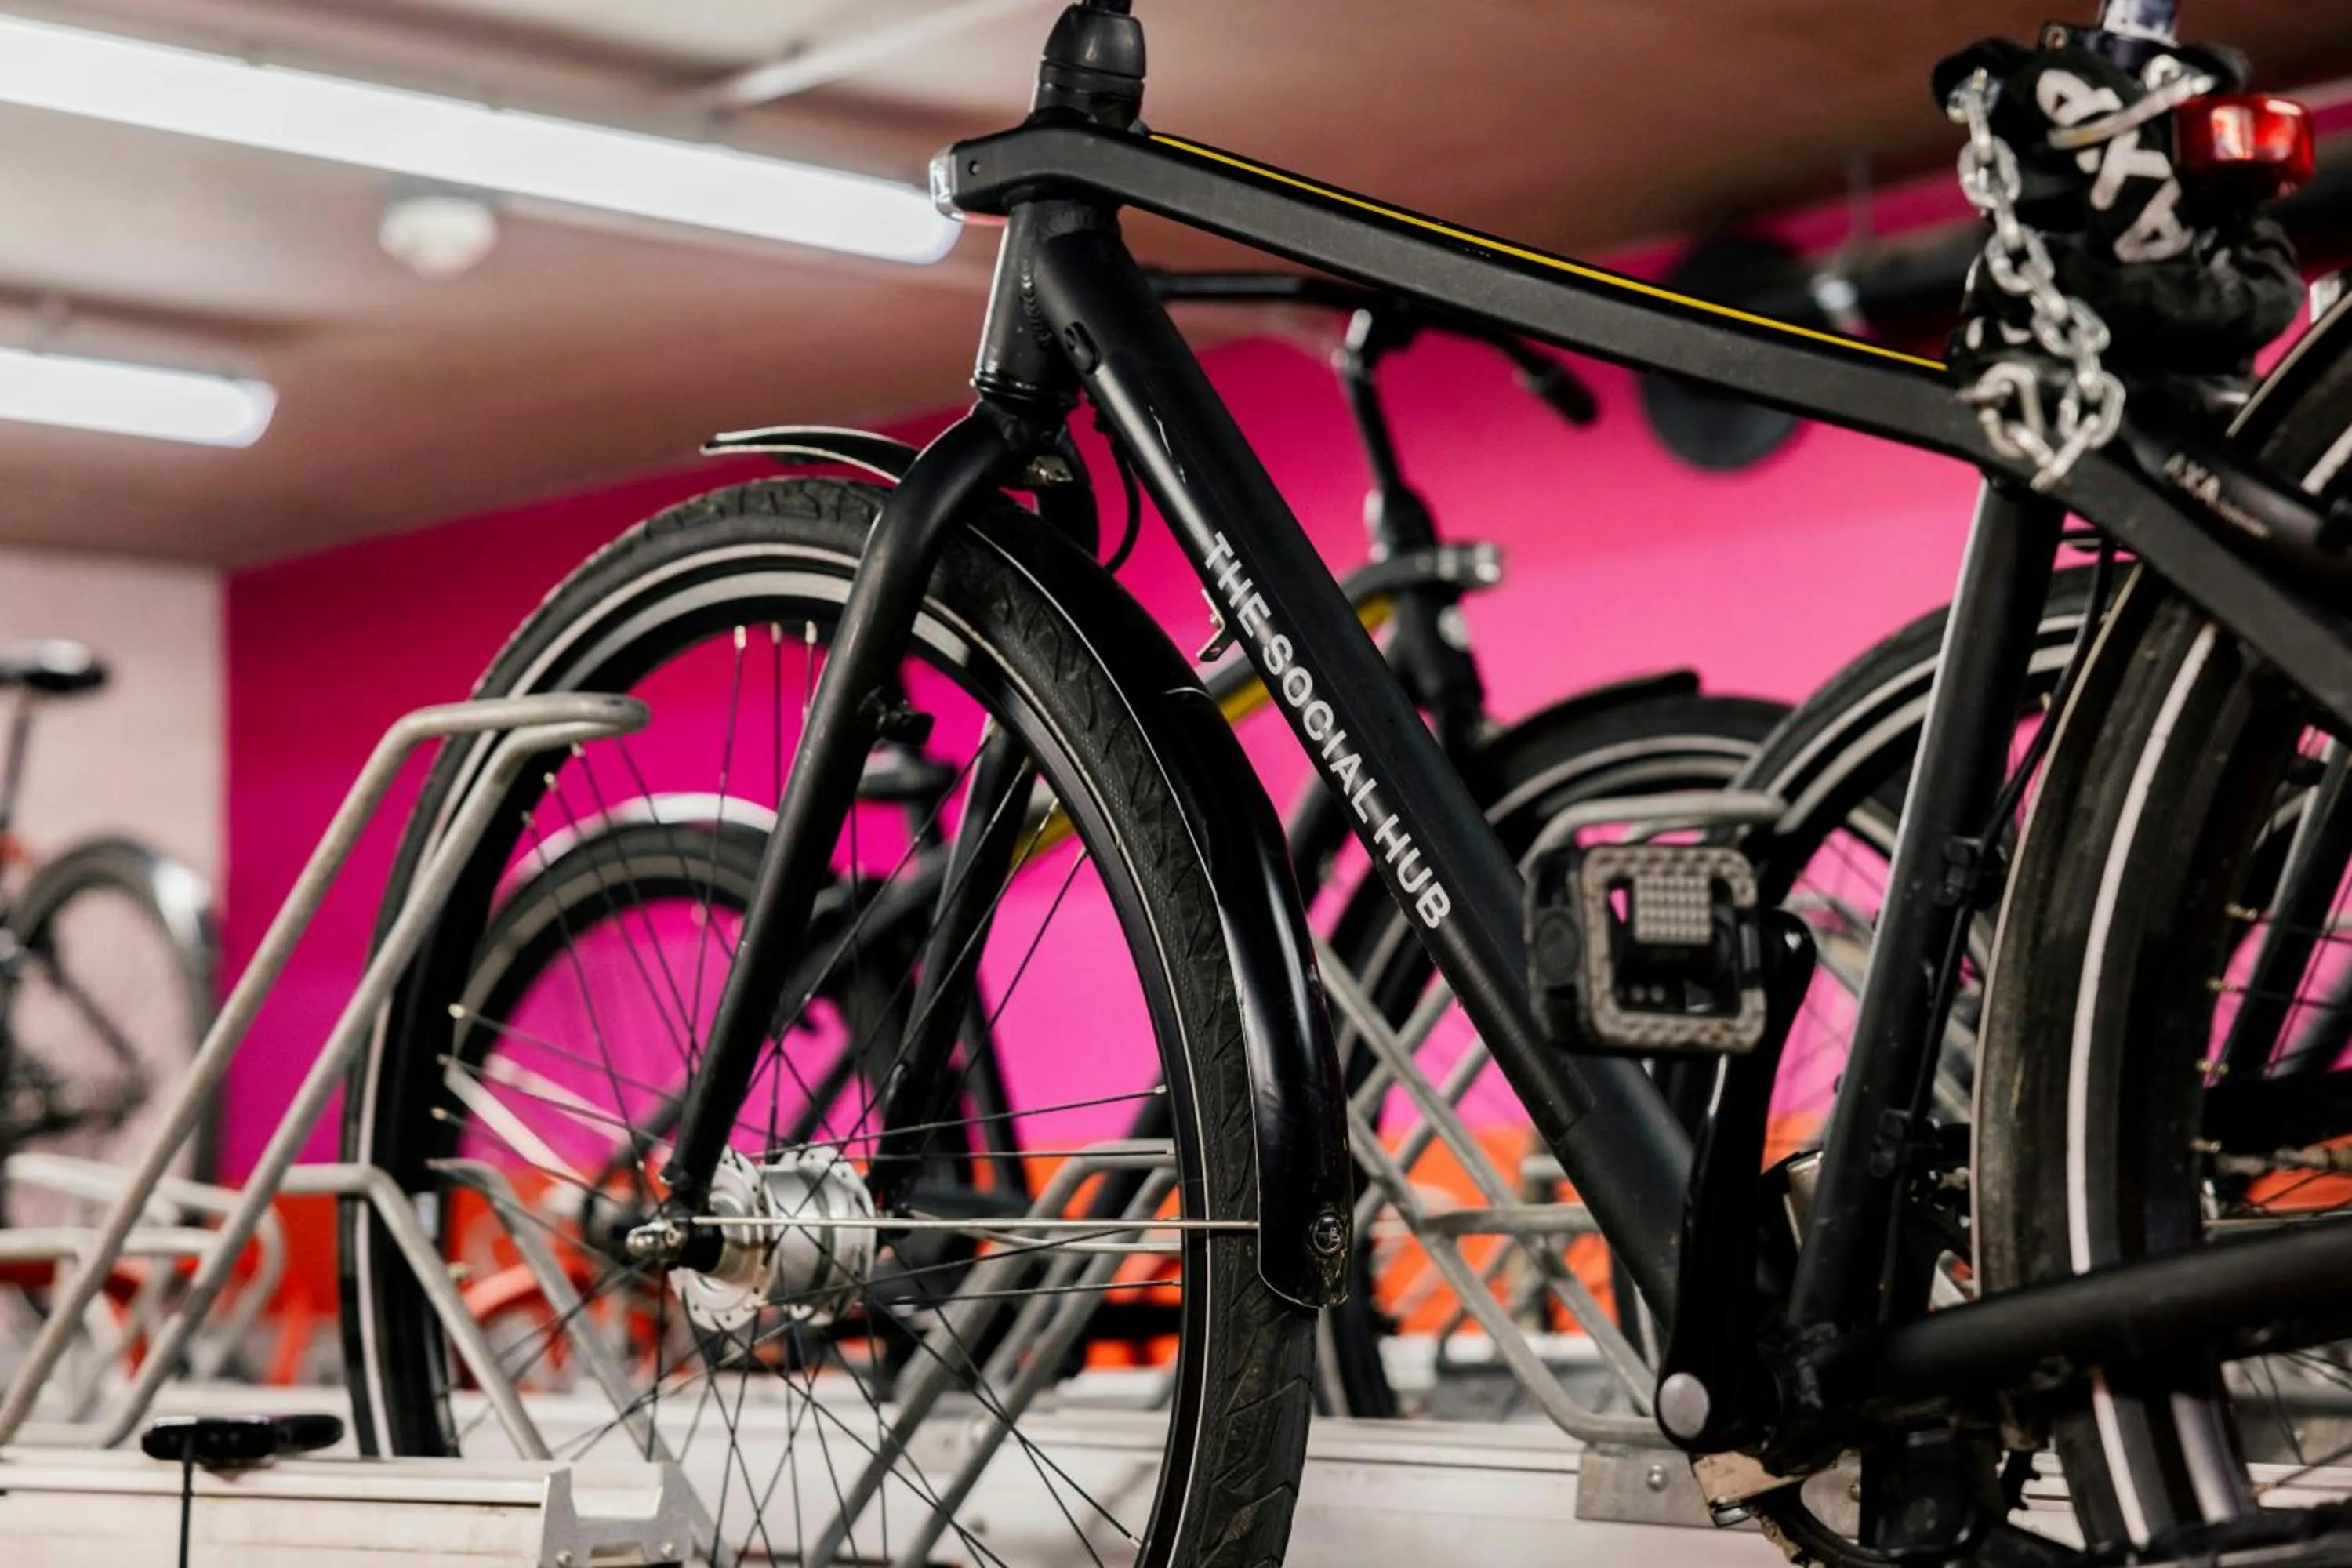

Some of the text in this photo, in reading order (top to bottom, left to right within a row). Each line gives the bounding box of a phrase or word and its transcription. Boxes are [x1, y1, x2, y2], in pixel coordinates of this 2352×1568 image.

[2037, 69, 2194, 263] AXA
[2164, 452, 2220, 506] AXA
[1205, 532, 1451, 929] THE SOCIAL HUB
